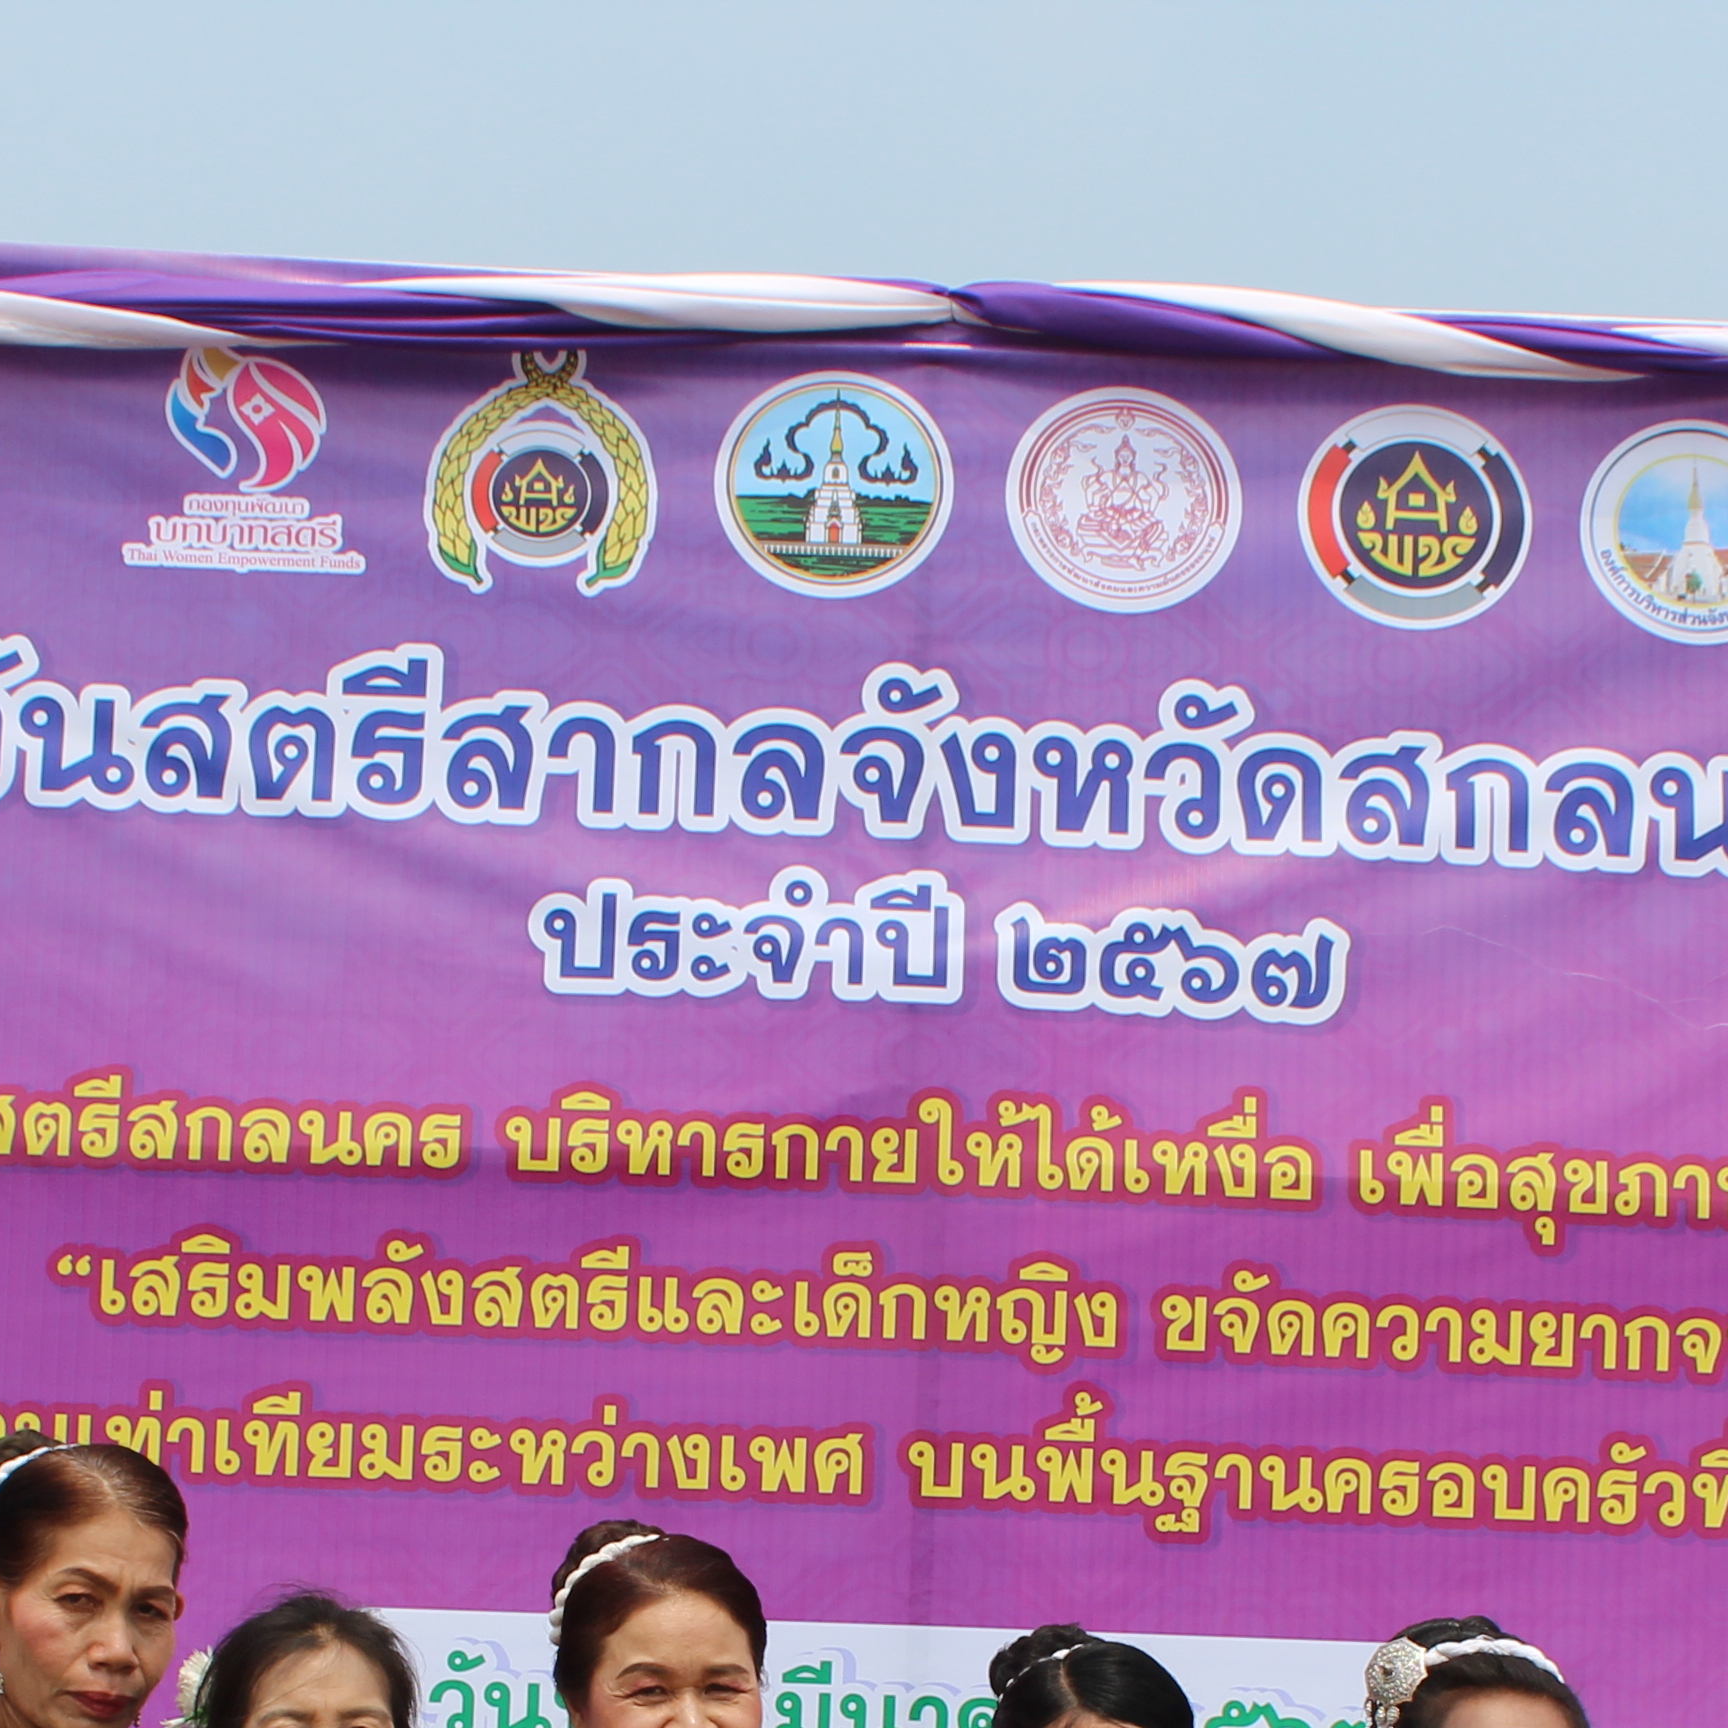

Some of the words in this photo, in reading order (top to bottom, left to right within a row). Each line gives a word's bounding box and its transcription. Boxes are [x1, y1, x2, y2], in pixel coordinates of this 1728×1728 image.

[154, 519, 338, 549] บทบาทสตรี
[187, 494, 306, 516] กองทุนพัฒนา
[127, 548, 159, 562] Thai
[162, 550, 214, 564] Women
[217, 554, 317, 568] Empowerment
[320, 556, 361, 569] Funds
[543, 880, 949, 988] ประจำปี
[1011, 917, 1333, 1008] ๒๕๖๗
[506, 1096, 1313, 1200] บริหารกายให้ได้เหงื่อ
[56, 1234, 1119, 1364] “เสริมพลังสตรีและเด็กหญิง
